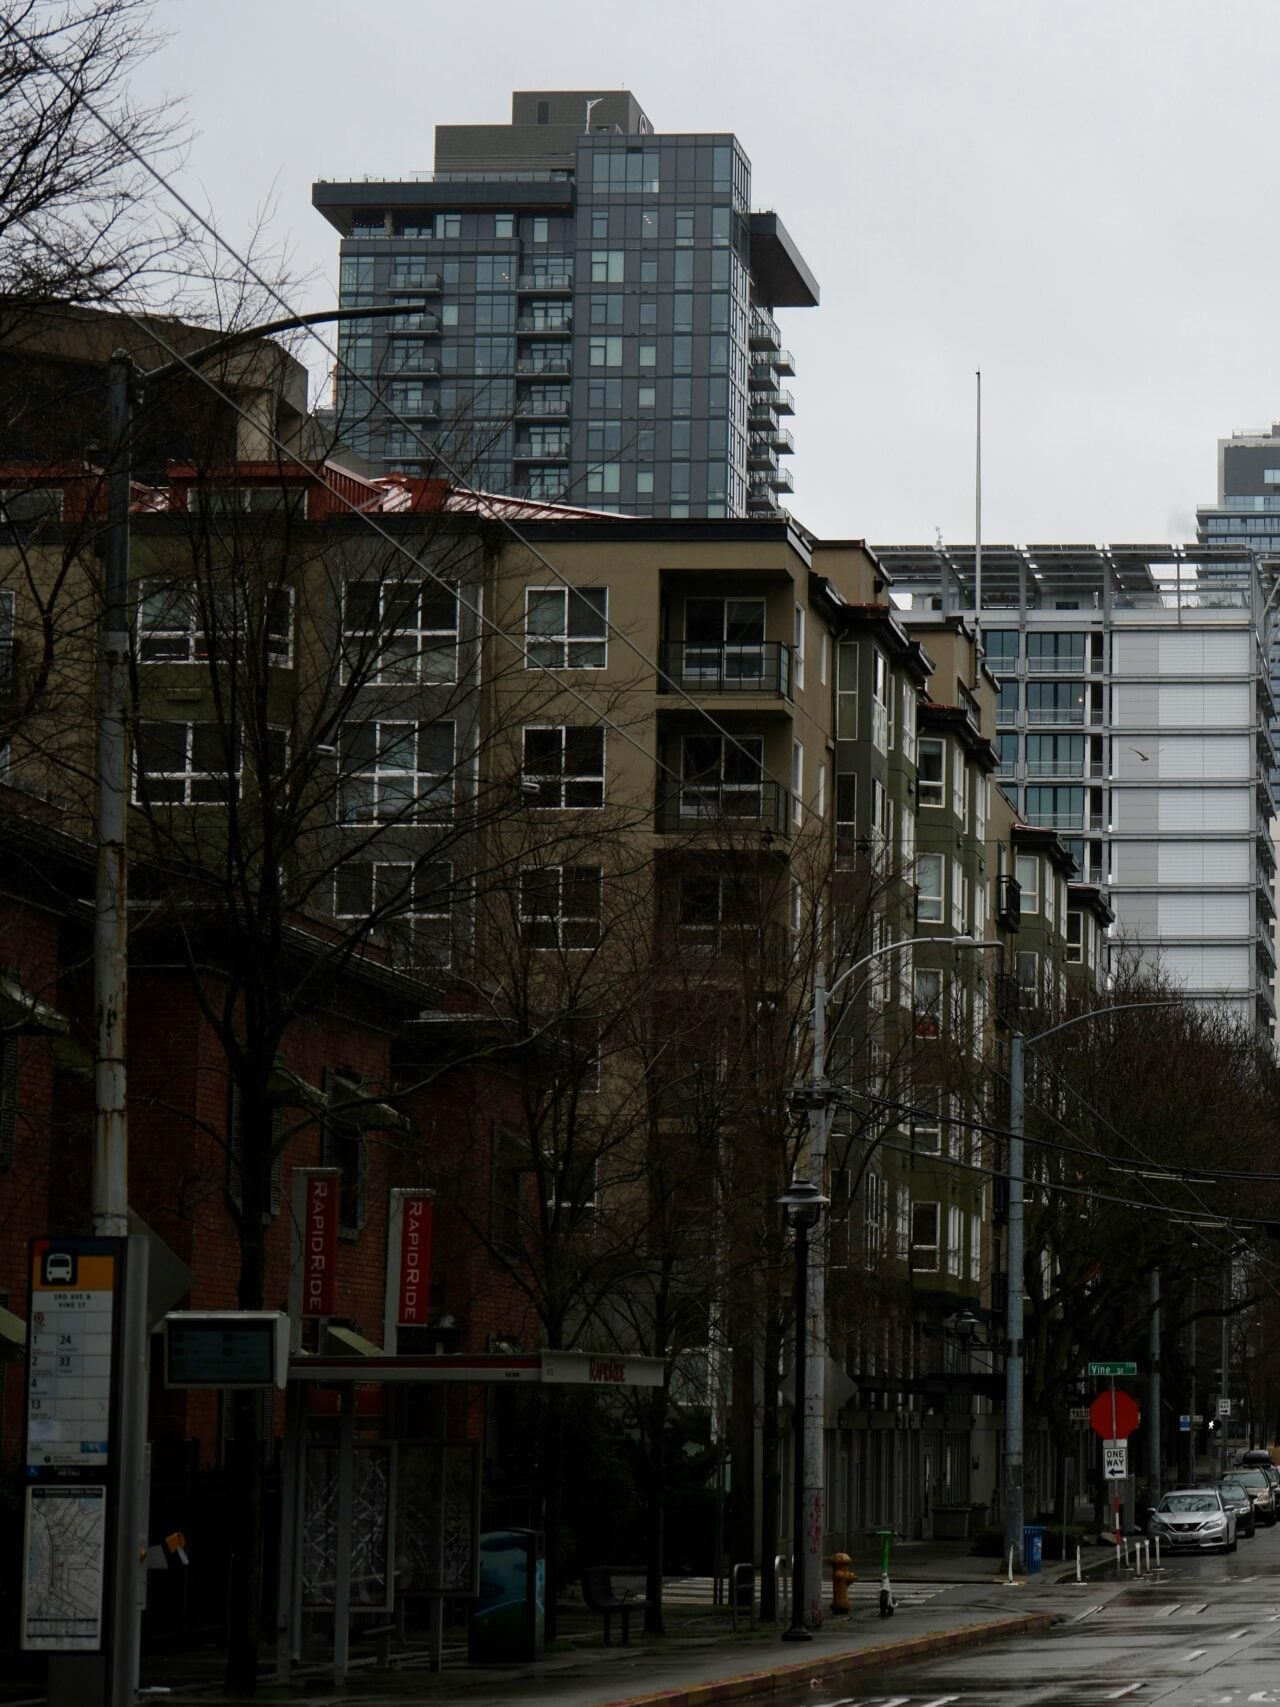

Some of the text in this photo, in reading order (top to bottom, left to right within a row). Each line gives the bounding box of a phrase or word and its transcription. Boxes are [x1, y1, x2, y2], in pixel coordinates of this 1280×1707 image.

[33, 1335, 72, 1345] 1 24
[31, 1356, 71, 1367] 2 33
[1091, 1365, 1111, 1375] Vine
[31, 1379, 37, 1388] 4
[31, 1400, 41, 1410] 13
[1107, 1450, 1124, 1458] ONE
[1106, 1459, 1124, 1467] WAY
